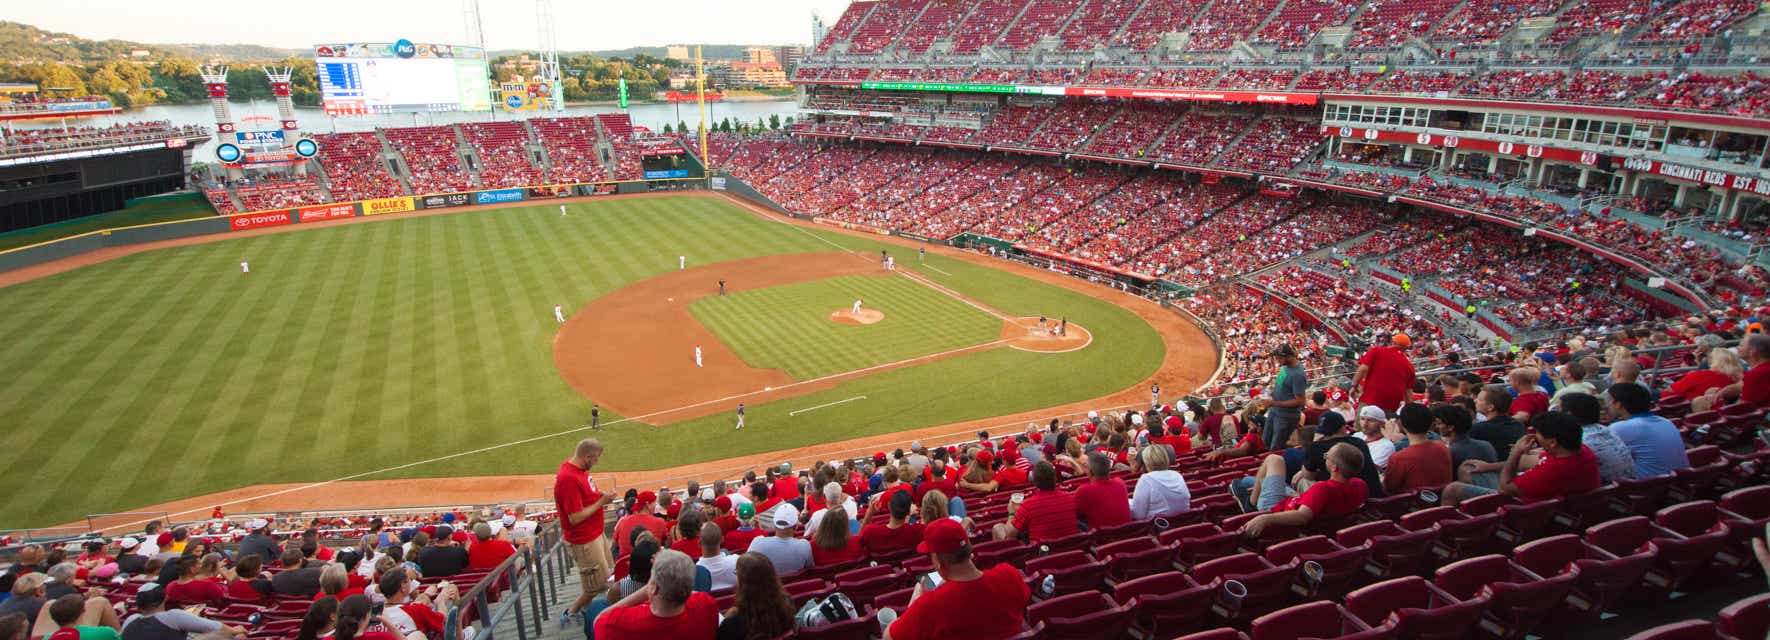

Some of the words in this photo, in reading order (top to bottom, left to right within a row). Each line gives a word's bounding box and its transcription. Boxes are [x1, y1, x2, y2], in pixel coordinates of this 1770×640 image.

[254, 131, 278, 139] PNC
[1659, 164, 1703, 182] CINCINNATI
[1704, 170, 1727, 185] REDS
[1733, 175, 1753, 191] EST.
[448, 194, 468, 202] JACK
[371, 199, 407, 210] OLLIE'S
[251, 214, 287, 224] TOYOTA
